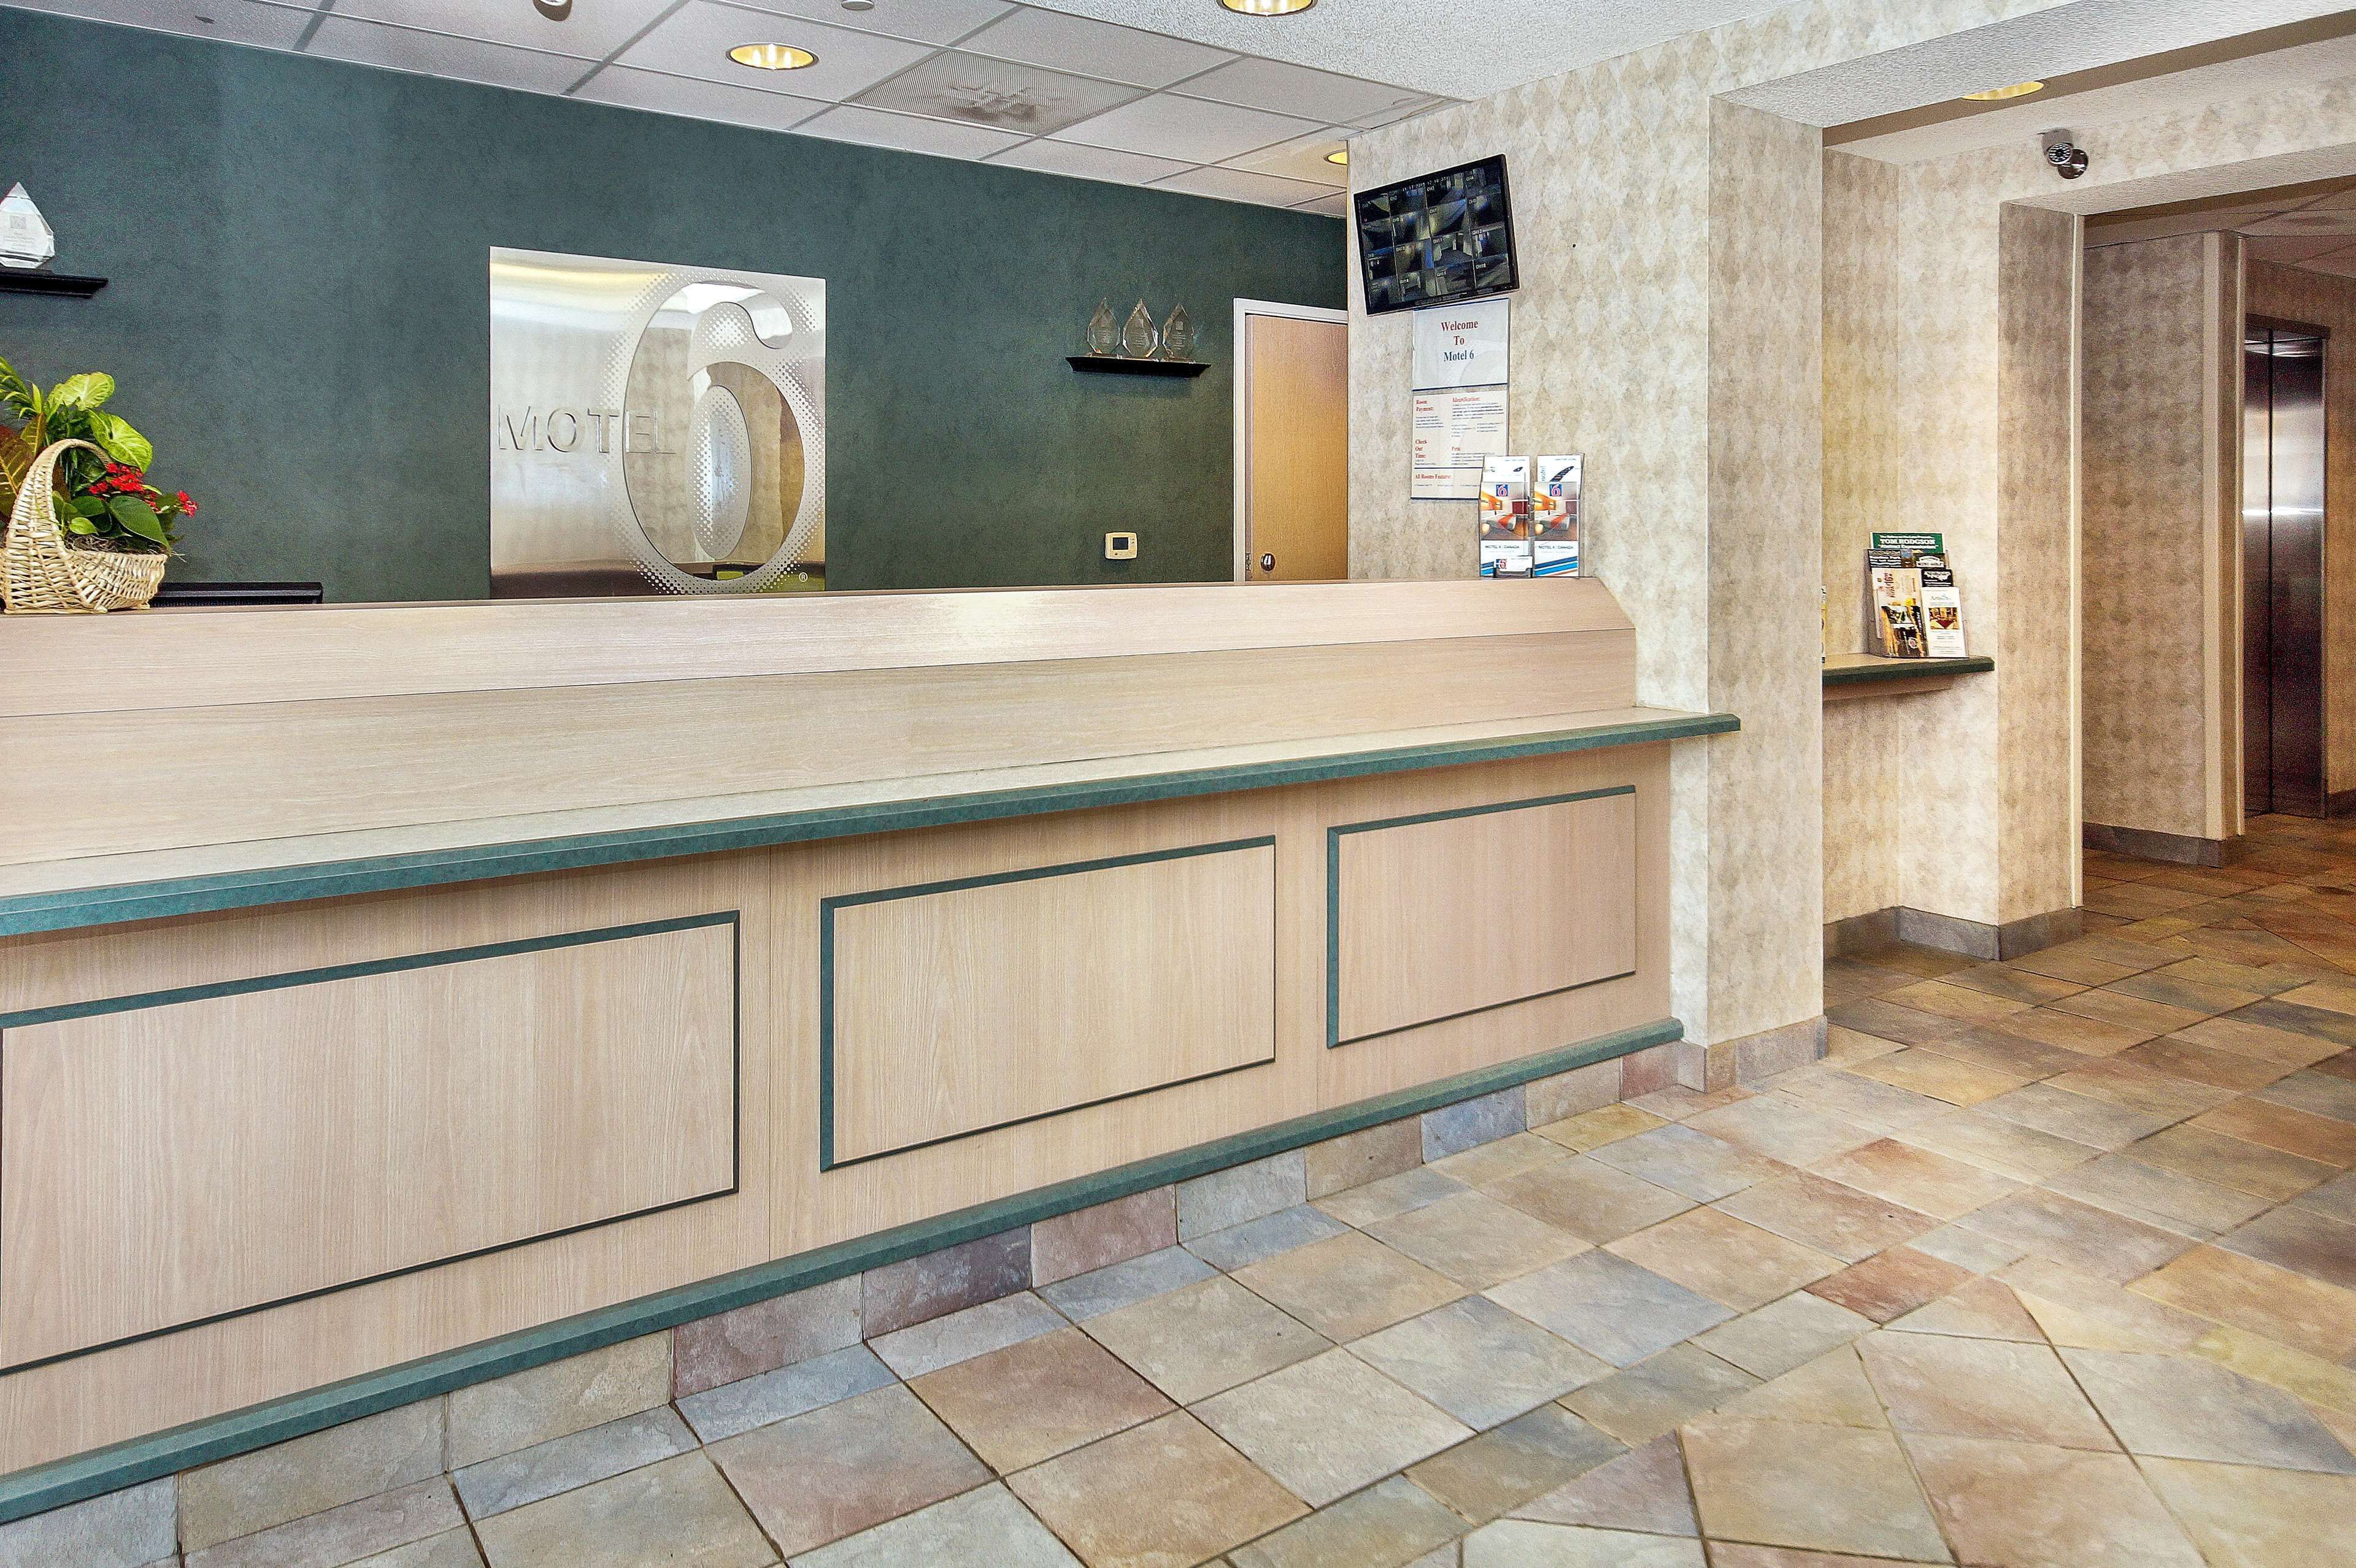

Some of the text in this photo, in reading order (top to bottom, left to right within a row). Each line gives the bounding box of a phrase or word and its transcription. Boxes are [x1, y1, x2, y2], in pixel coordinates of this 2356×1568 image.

[1441, 320, 1479, 331] Welcome
[1453, 336, 1465, 345] To
[1444, 349, 1474, 362] Motel 6
[496, 282, 806, 581] MOTEL 6
